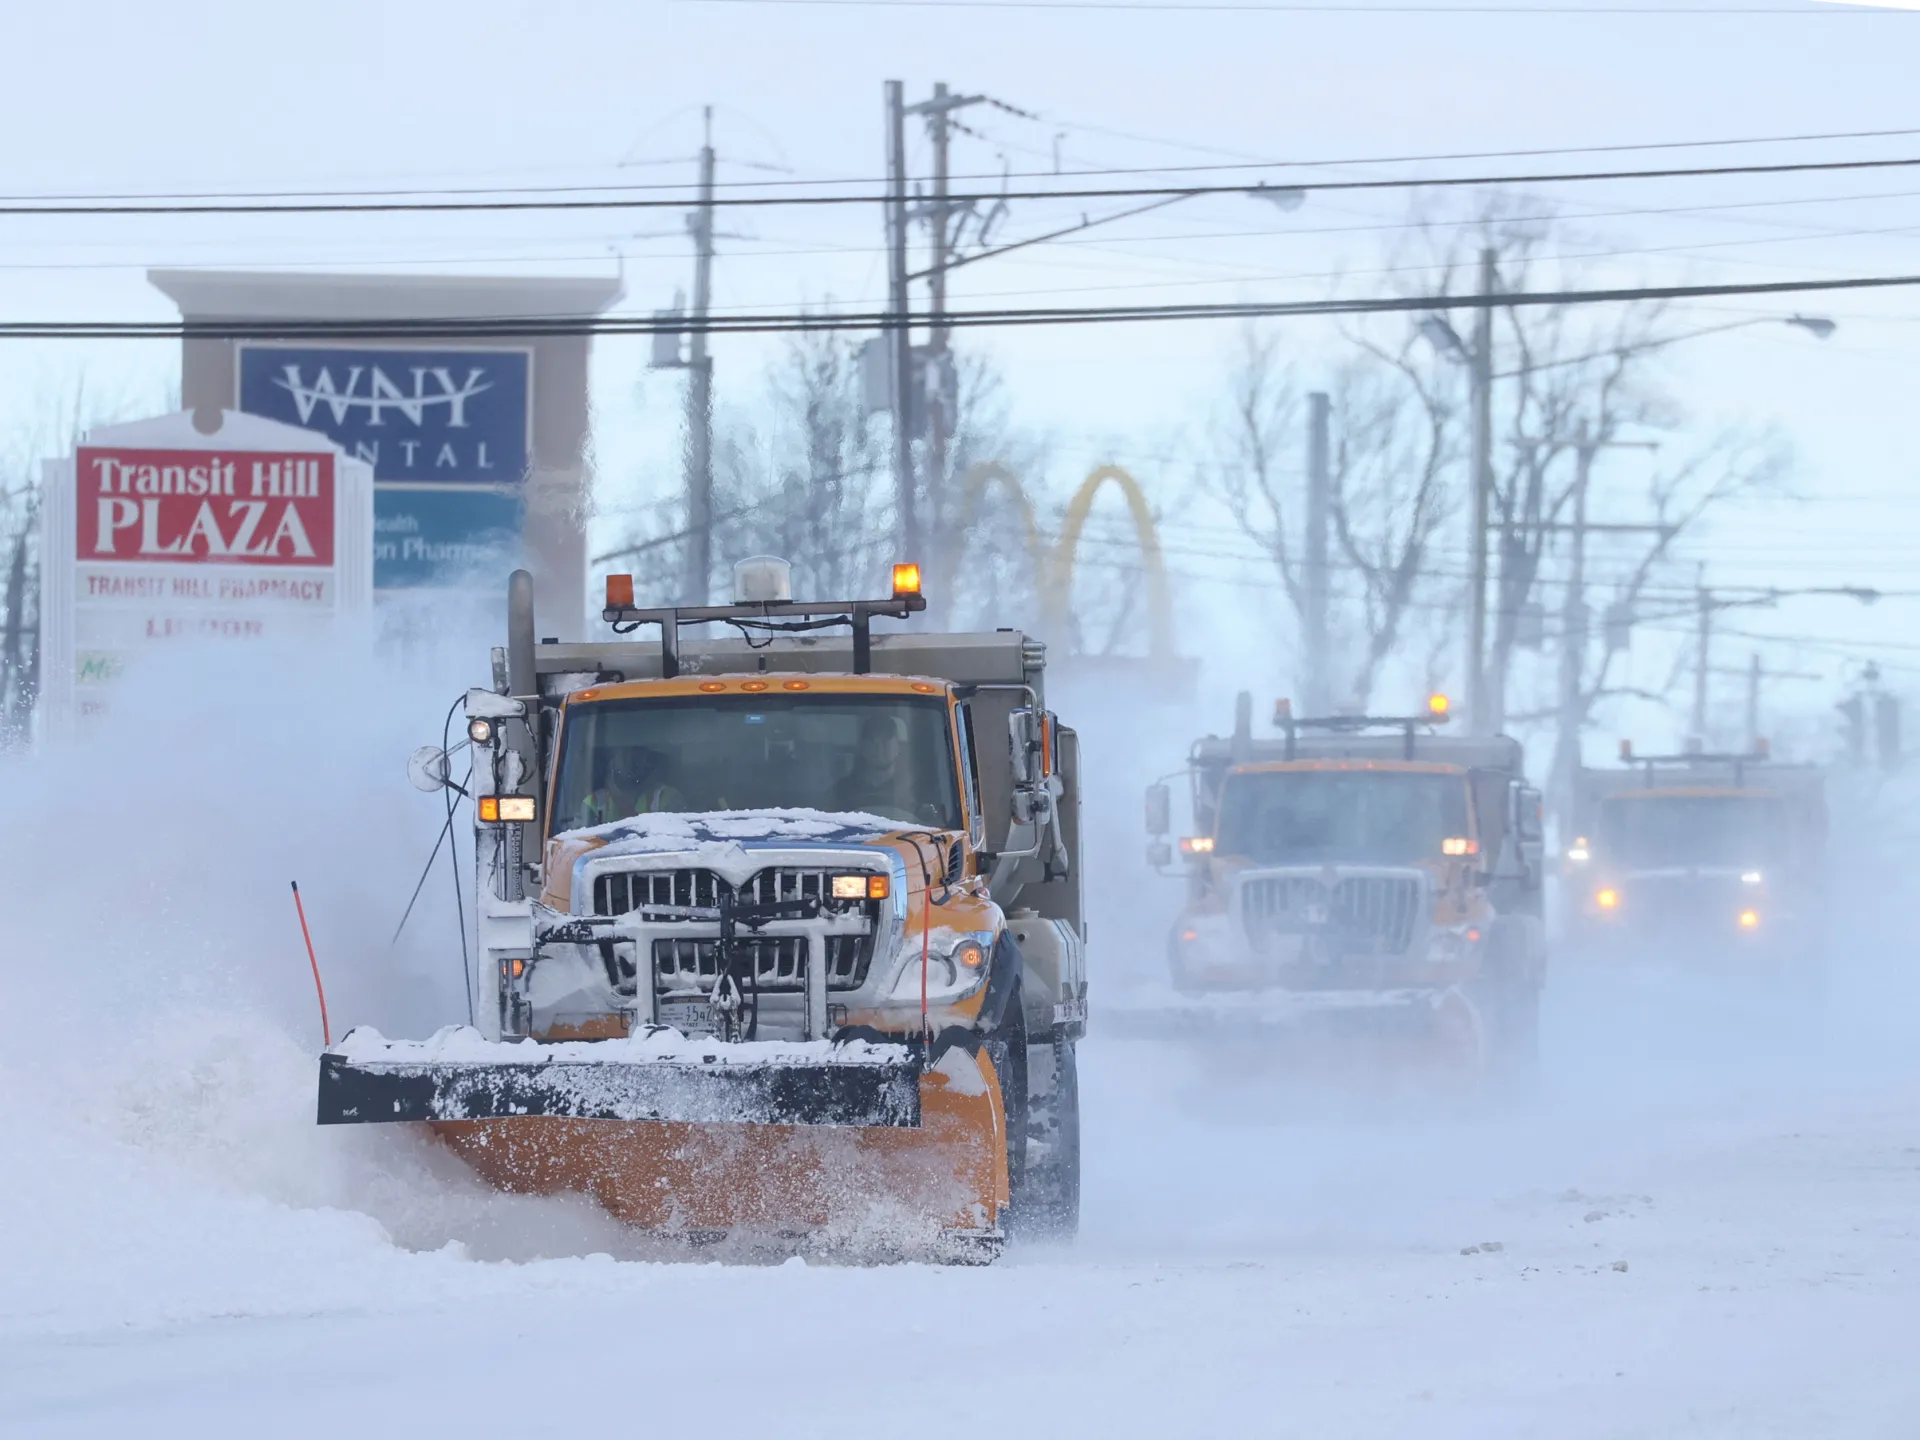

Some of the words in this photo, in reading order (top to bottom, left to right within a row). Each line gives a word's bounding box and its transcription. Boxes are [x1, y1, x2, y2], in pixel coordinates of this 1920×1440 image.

[279, 364, 486, 428] WNY
[92, 457, 237, 496] Transit
[251, 459, 319, 498] Hill
[94, 497, 317, 558] PLAZA
[402, 537, 500, 560] Pharm
[86, 576, 166, 597] TRANSIT
[172, 578, 213, 598] HILL
[219, 579, 325, 601] PHARMACY
